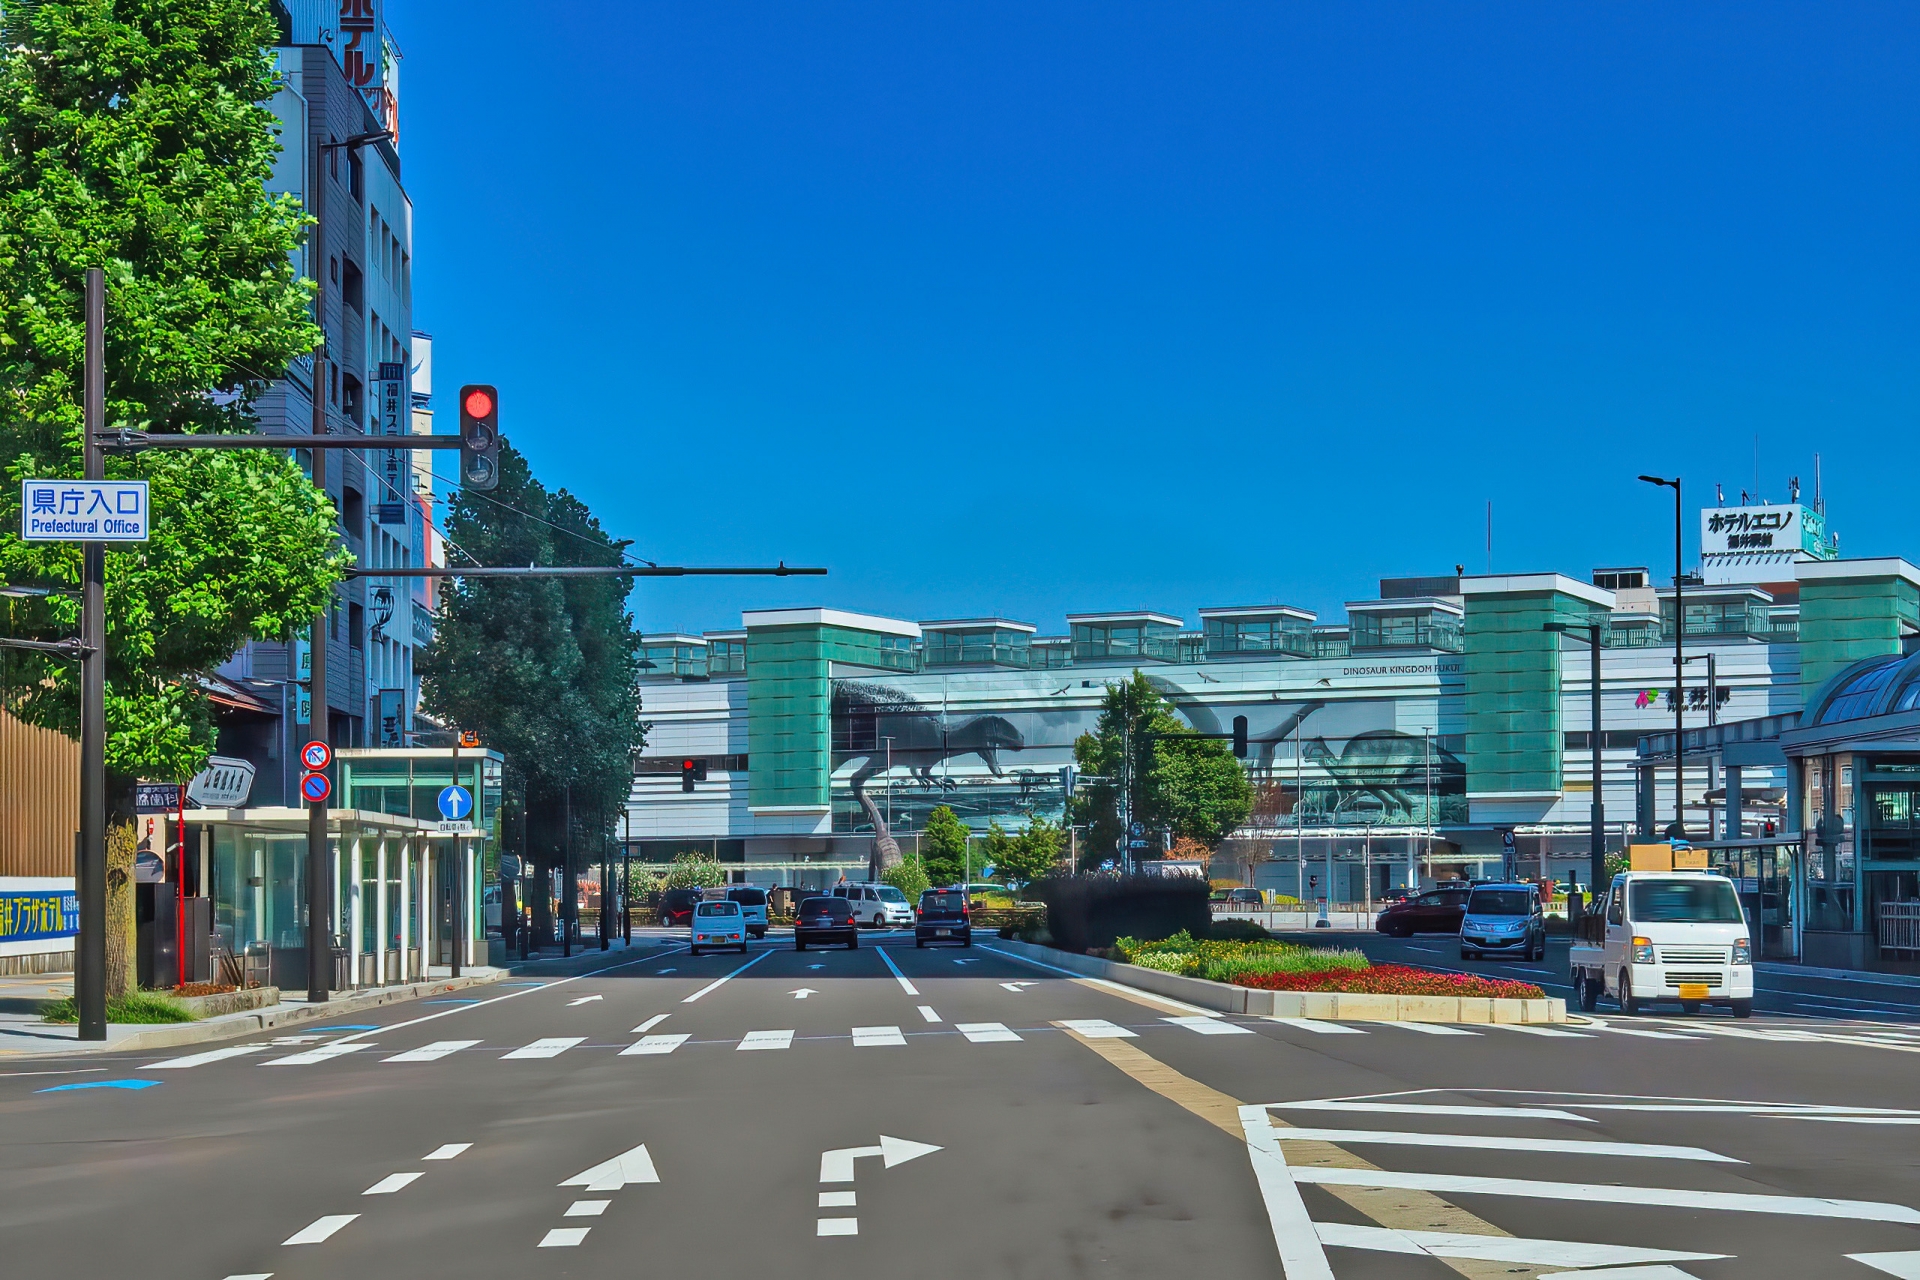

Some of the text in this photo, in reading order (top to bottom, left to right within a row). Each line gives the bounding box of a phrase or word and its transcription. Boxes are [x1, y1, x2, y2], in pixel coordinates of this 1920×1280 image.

[32, 488, 139, 515] 県庁入口
[32, 519, 140, 533] Prefectural Office
[1708, 511, 1793, 533] ホテルエコノ
[1343, 667, 1387, 675] DINOSAUR
[1389, 665, 1432, 674] KINGDOM
